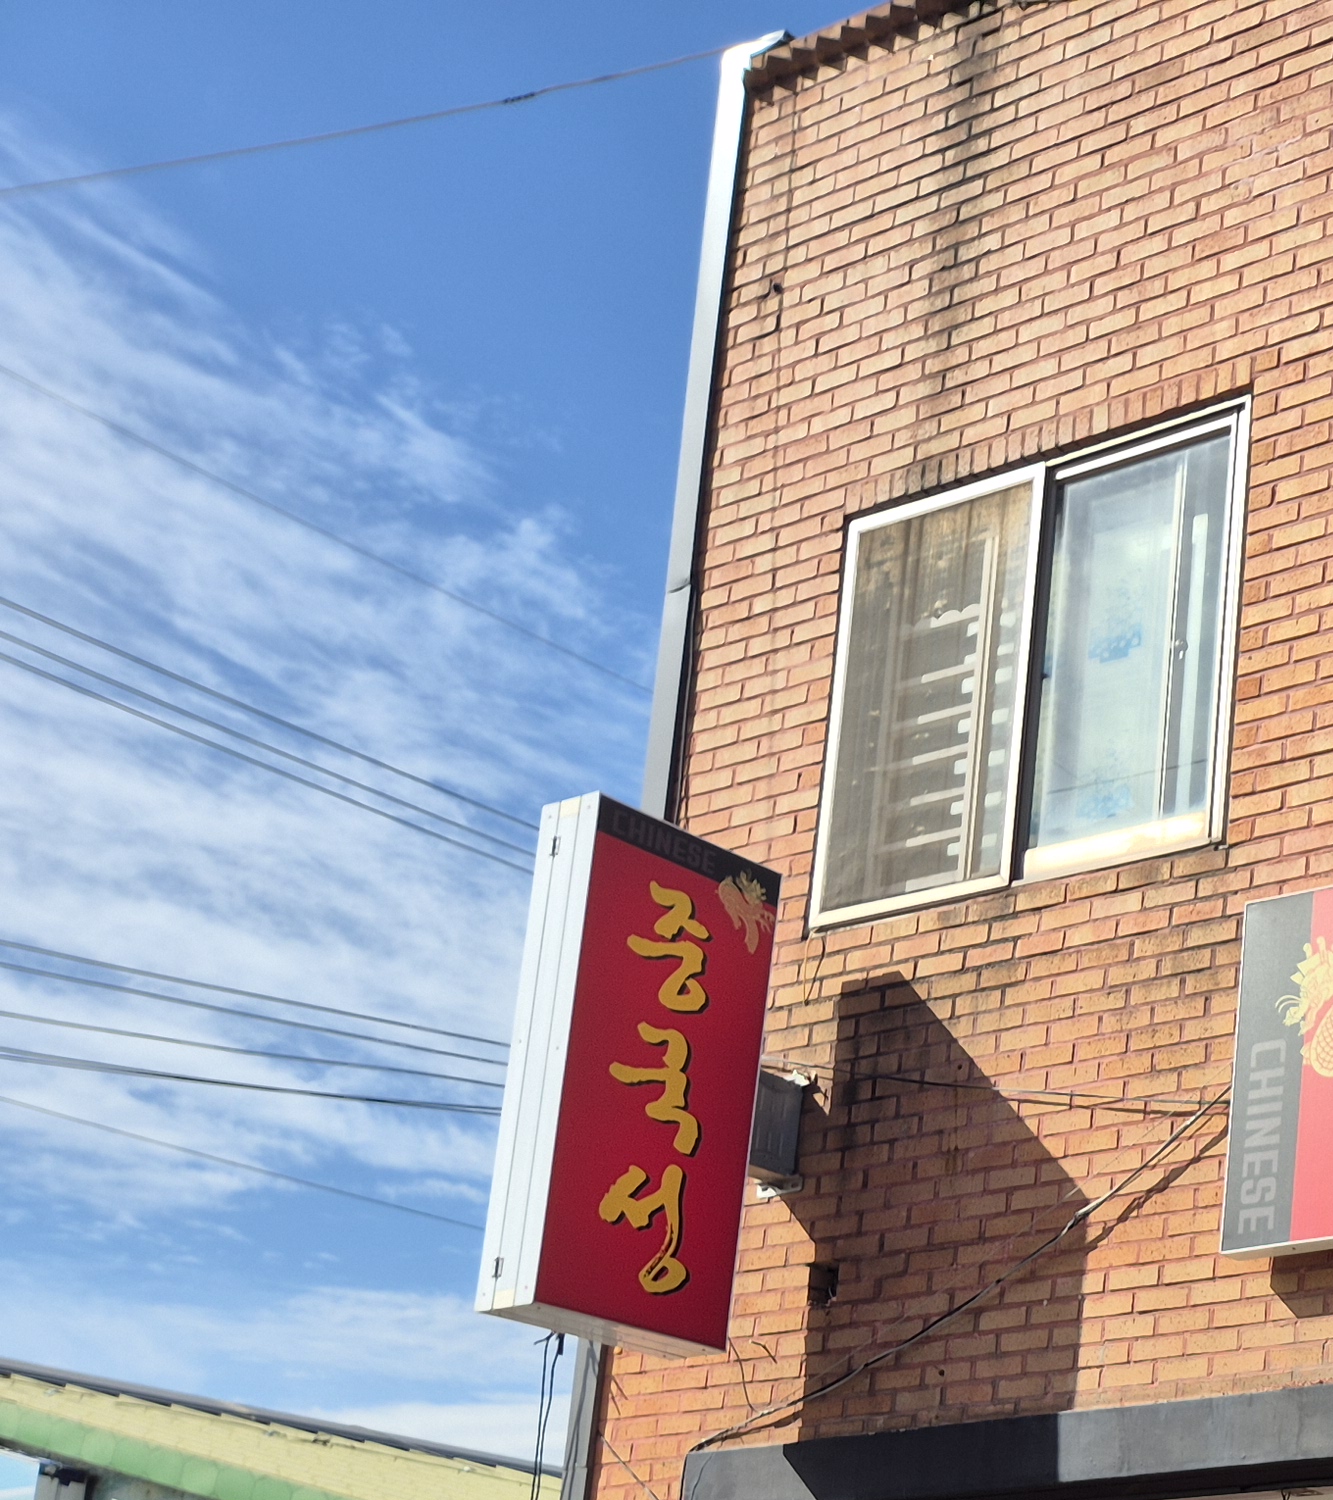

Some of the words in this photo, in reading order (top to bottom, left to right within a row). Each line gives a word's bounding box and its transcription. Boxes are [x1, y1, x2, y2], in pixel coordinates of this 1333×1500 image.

[612, 809, 717, 875] CHINESE
[598, 880, 711, 1296] 중국성
[1238, 1038, 1287, 1234] CHINESE
